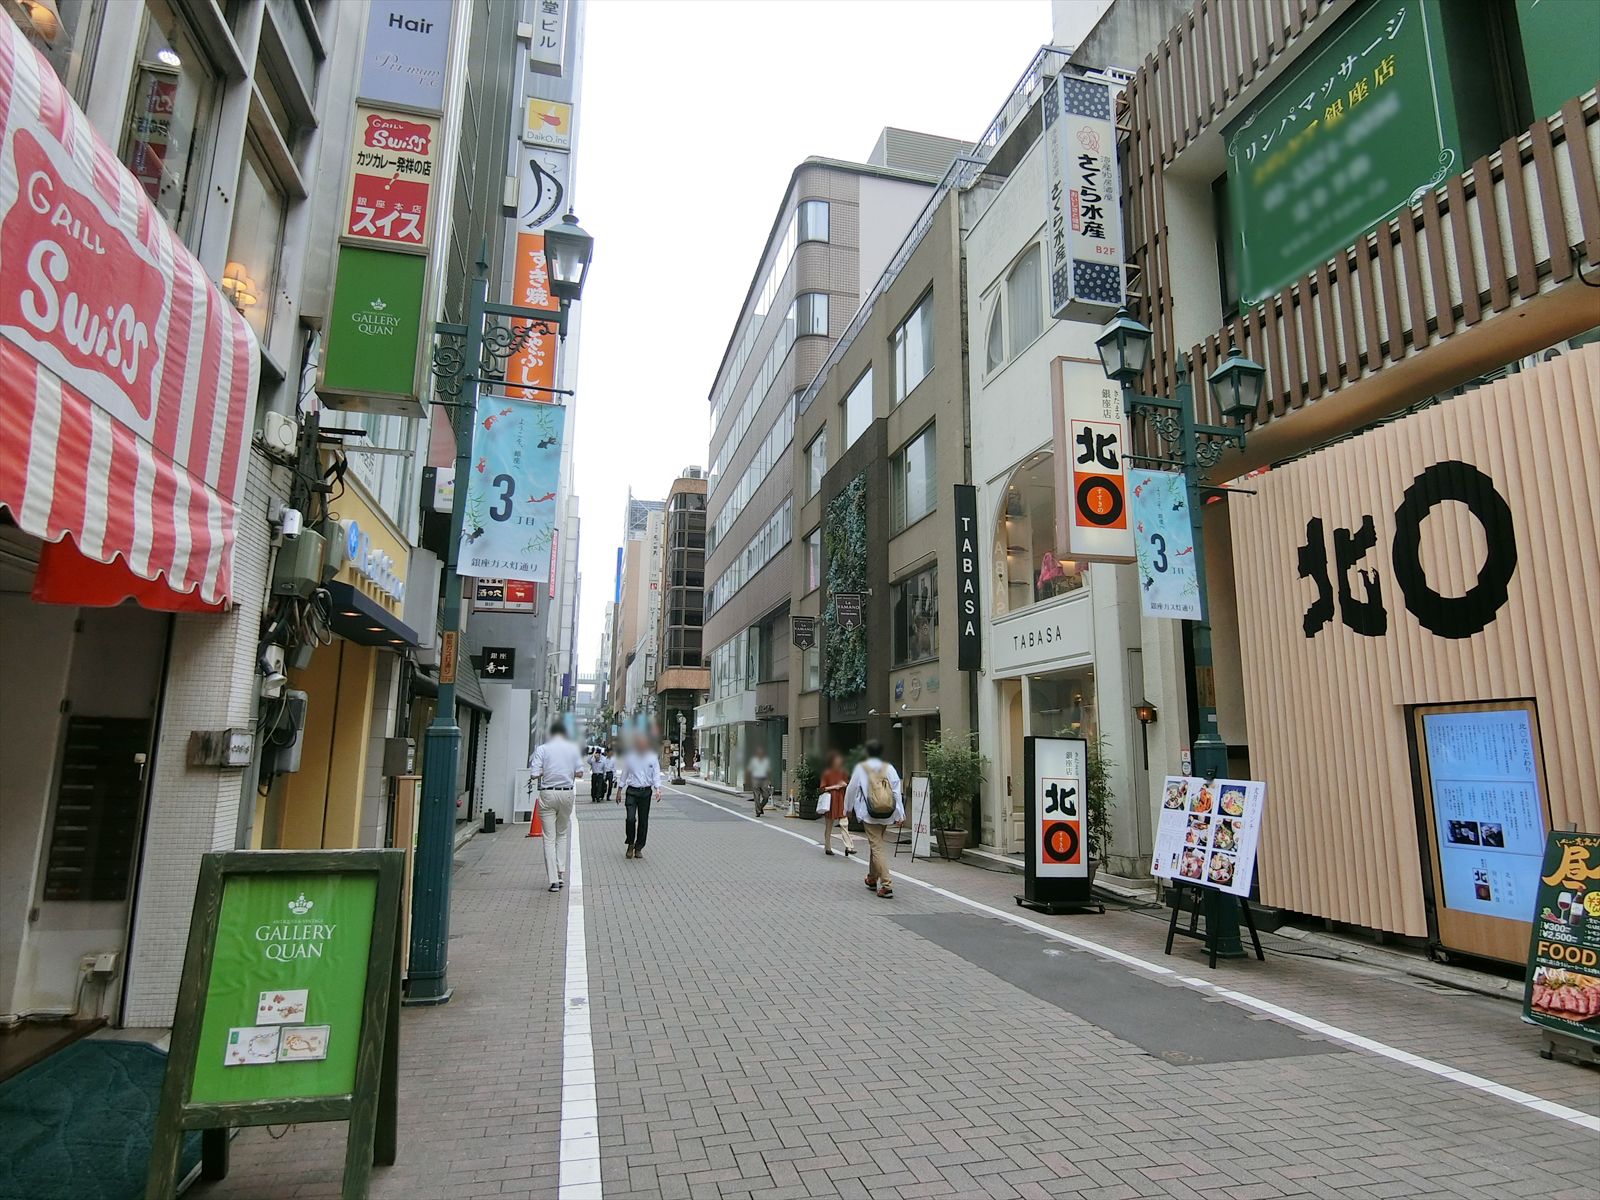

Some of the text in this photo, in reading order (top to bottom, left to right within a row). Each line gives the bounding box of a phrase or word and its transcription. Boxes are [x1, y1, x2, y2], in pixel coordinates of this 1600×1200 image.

[388, 12, 434, 34] Hair
[1245, 7, 1406, 163] リンパマッサージ
[372, 118, 404, 130] GRILL
[371, 129, 427, 153] Swiss
[356, 150, 432, 177] カツカレー発祥の店
[1077, 153, 1106, 240] さくら水産
[28, 171, 105, 255] GRILL
[352, 205, 422, 240] スイス
[1051, 180, 1066, 267] さくら水産
[1096, 245, 1116, 256] B2F
[20, 240, 149, 384] Swiss
[351, 312, 401, 326] GALLERY
[358, 323, 394, 336] QUAN
[1102, 389, 1111, 418] 銀座店
[489, 473, 516, 522] 3
[516, 515, 535, 526] 丁目
[470, 557, 538, 573] 銀座ガス灯通り
[1150, 533, 1168, 573] 3
[961, 517, 976, 637] TABASA
[1151, 602, 1194, 611] 銀座ガス灯通り
[1013, 625, 1062, 650] TABASA
[445, 633, 454, 675] 銀座ガス灯通り
[490, 652, 507, 660] 銀座
[255, 925, 337, 941] GALLERY
[266, 943, 323, 962] QUAN
[1537, 941, 1597, 966] FOOD
